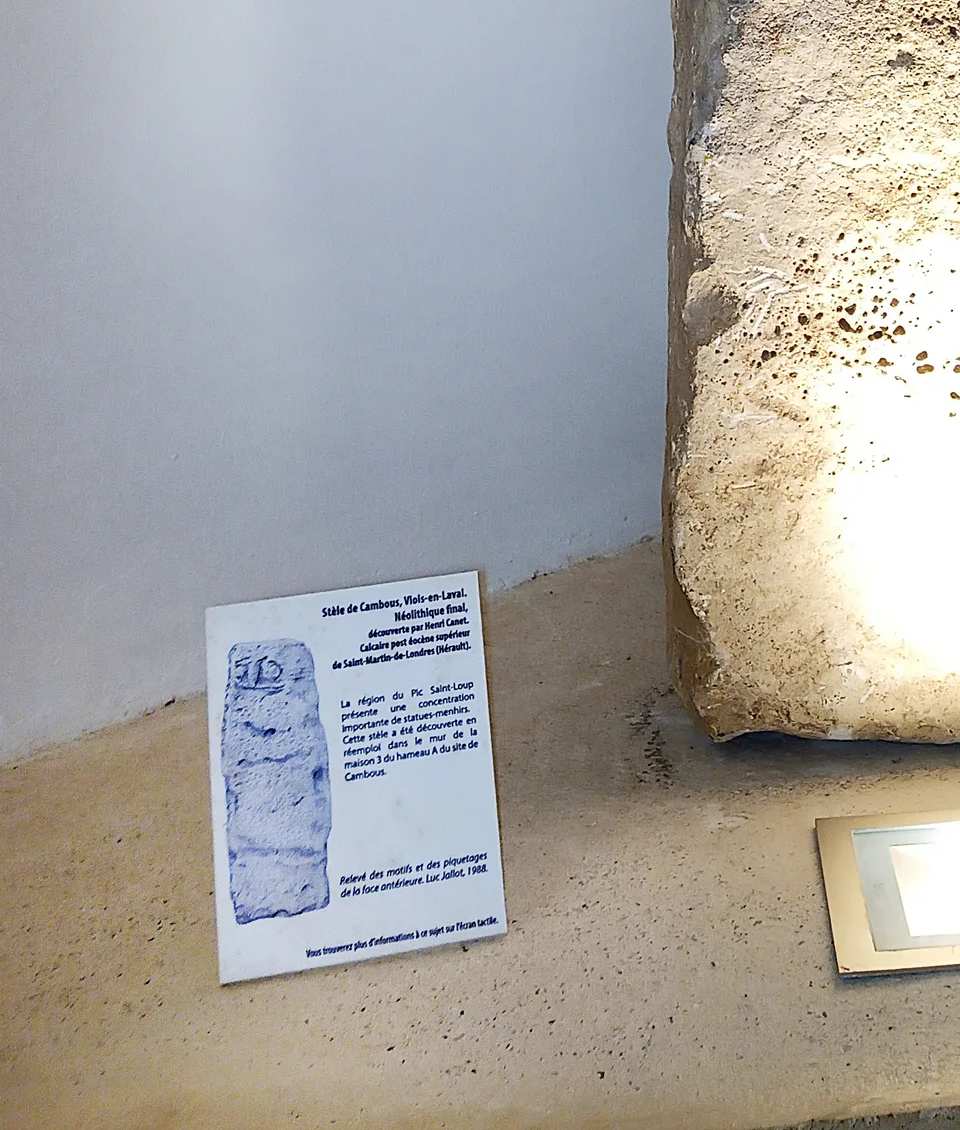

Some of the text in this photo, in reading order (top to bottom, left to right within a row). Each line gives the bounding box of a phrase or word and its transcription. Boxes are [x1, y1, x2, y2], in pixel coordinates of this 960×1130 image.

[322, 588, 467, 617] Stèle de Cambous, Viols-en-Laval.
[395, 603, 468, 622] Néolithique final,
[360, 629, 470, 652] Calcaire post éocène supérieur
[368, 617, 469, 638] découverte par Henri Canet.
[332, 642, 471, 670] de Saint-Martin-de-Londres (Hérault).
[342, 693, 474, 722] présente une concentration
[358, 695, 385, 706] région
[393, 692, 404, 700] du
[411, 688, 423, 697] Pic
[431, 681, 474, 695] Saint-Loup
[343, 706, 470, 732] importante de statues-menhirs.
[343, 735, 365, 744] Cette
[369, 730, 388, 741] stèle
[400, 726, 413, 735] été
[417, 719, 463, 732] découverte
[344, 728, 477, 757] réemploi dans le mur de la
[344, 740, 478, 769] maison 3 du hameau A du site de
[345, 768, 387, 781] Cambous.
[340, 852, 487, 885] Relevé des motifs et des piquetages
[341, 864, 488, 898] de la face antérieure. Luc Jallot, 1988.
[306, 916, 498, 958] Vous trouverez plus d'informations à ce sujet sur l'écran tactile.
